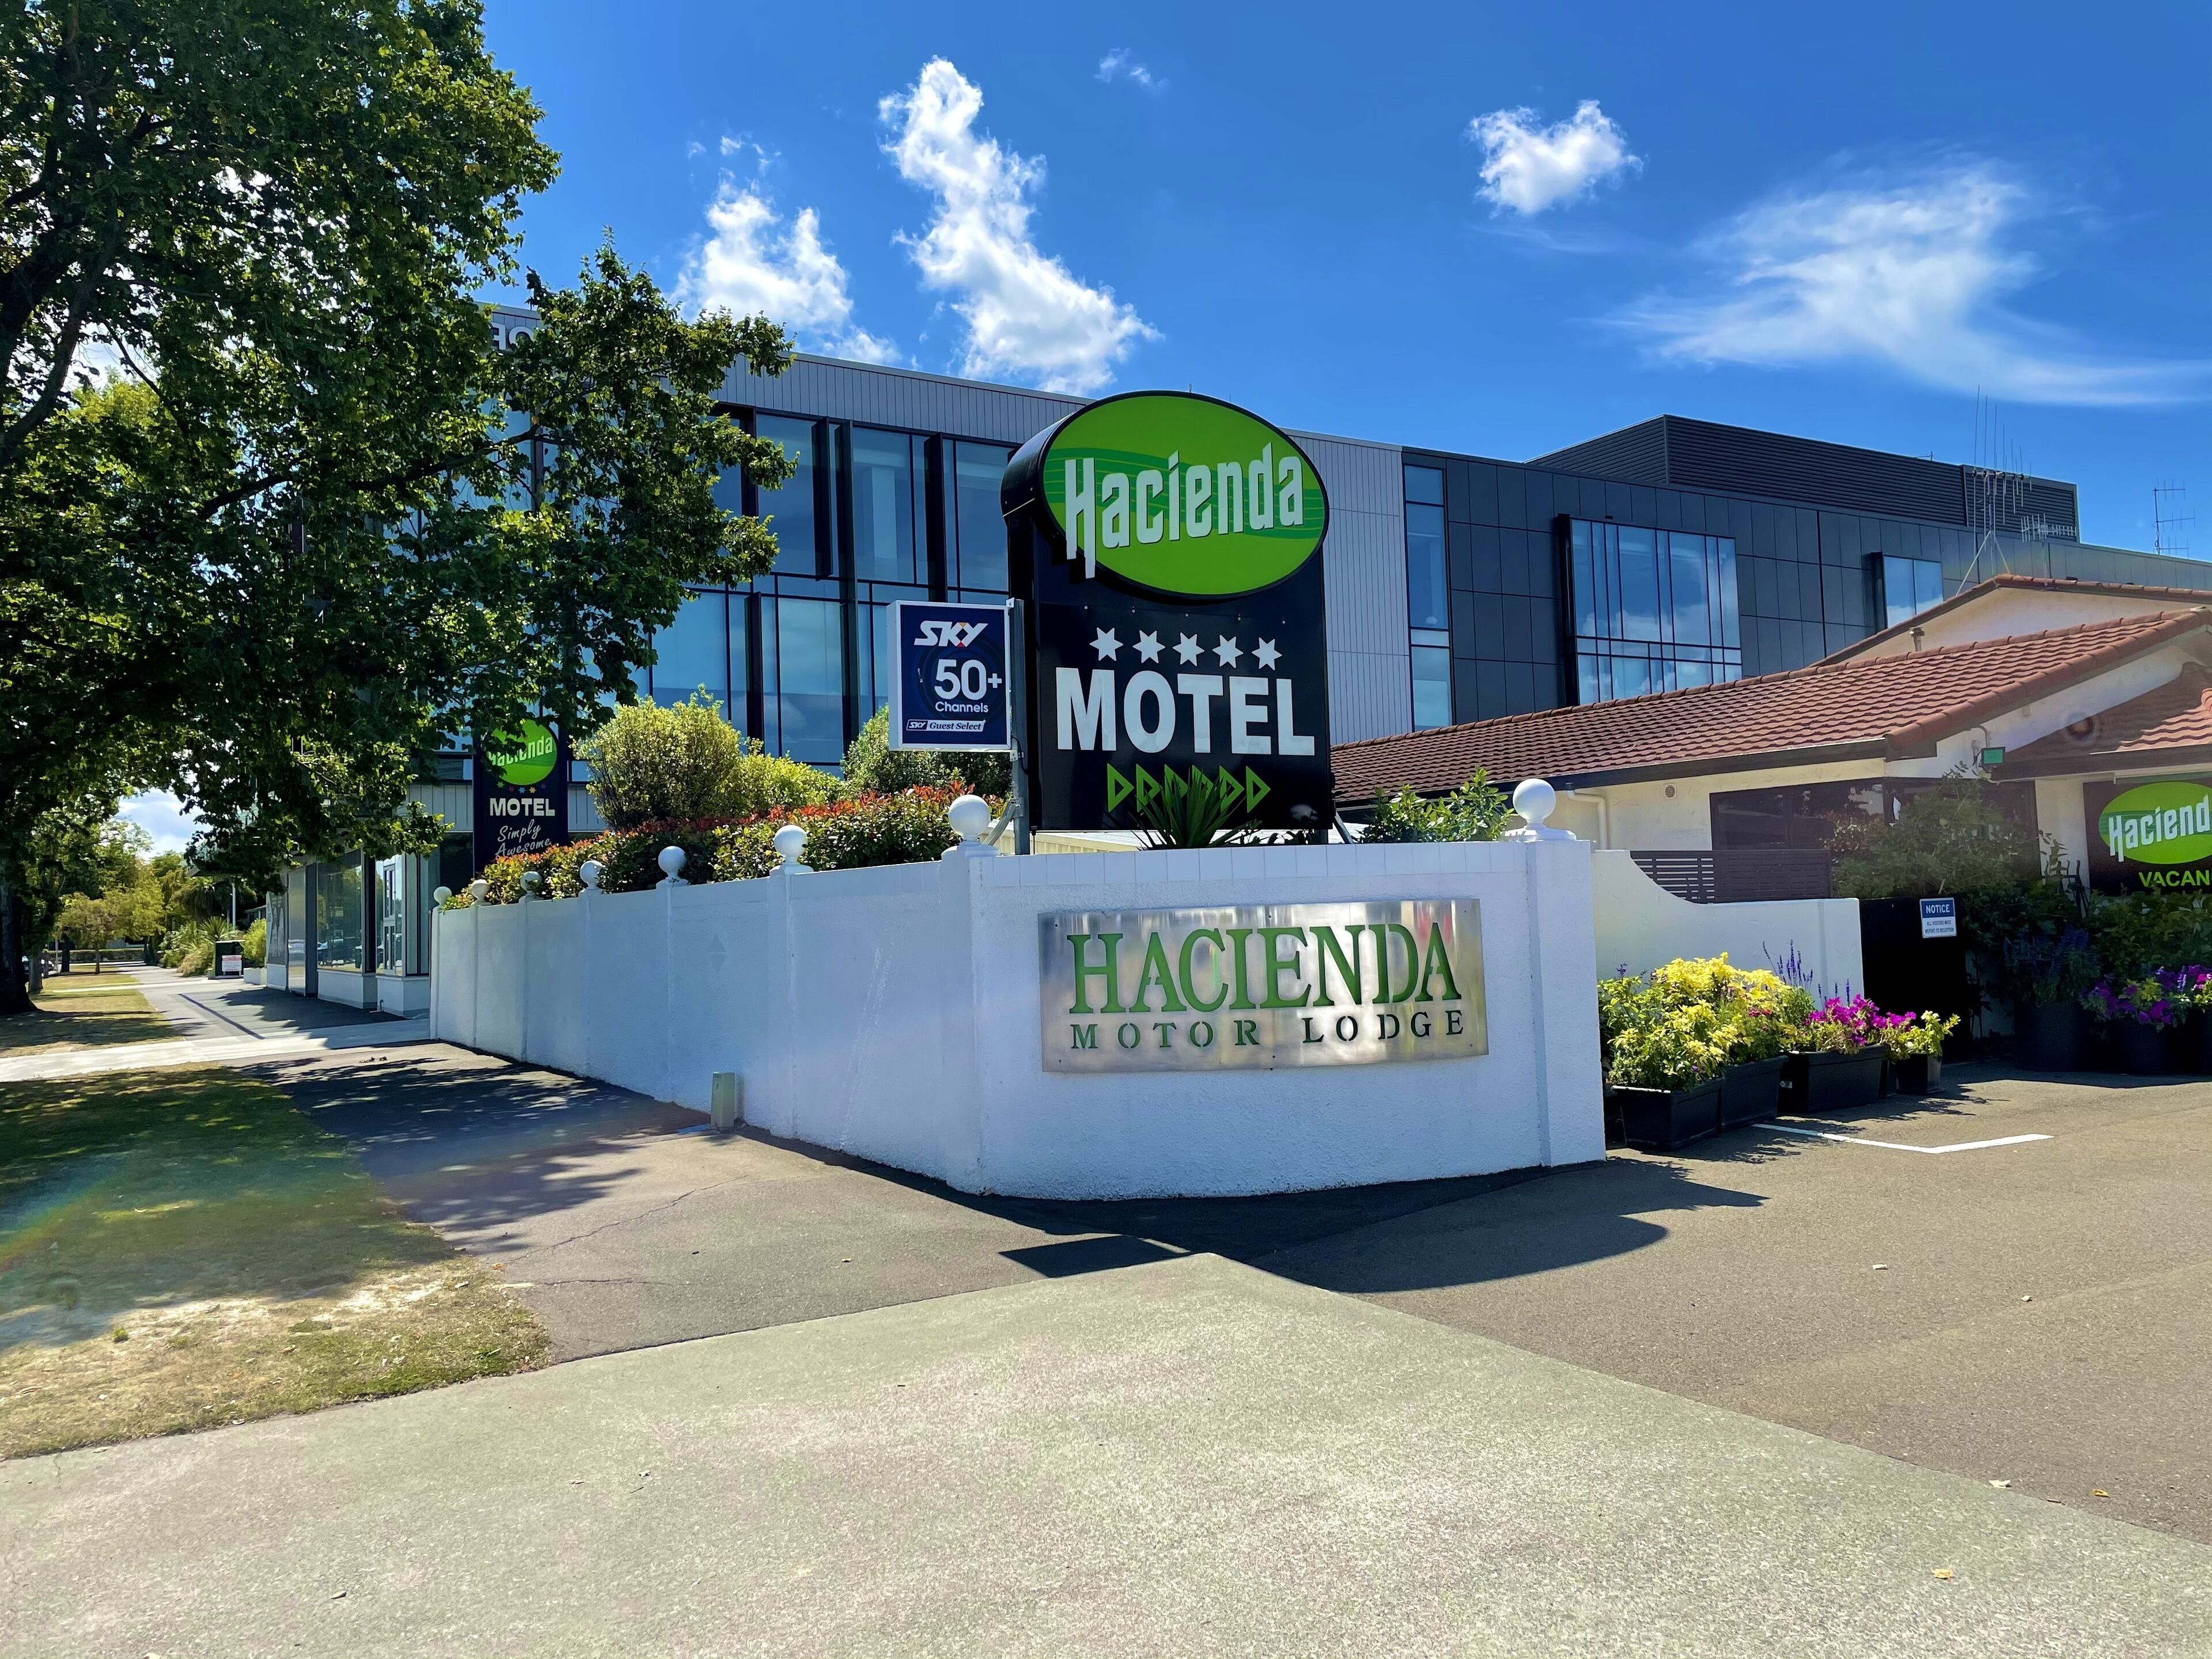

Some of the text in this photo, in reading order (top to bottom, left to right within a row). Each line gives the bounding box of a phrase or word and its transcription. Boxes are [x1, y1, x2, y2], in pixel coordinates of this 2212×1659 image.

[1064, 442, 1305, 579] Hacienda
[914, 620, 988, 647] SKY
[934, 659, 1002, 700] 50+
[935, 701, 988, 713] Channels
[1055, 667, 1315, 756] MOTEL
[490, 798, 555, 816] MOTEL
[497, 819, 541, 843] Simply
[2108, 794, 2211, 862] Haciend
[494, 838, 552, 858] Awesome
[2138, 870, 2212, 887] VACAN
[1926, 904, 1950, 914] NOTICE
[1066, 922, 1462, 1014] HACIENDA
[1070, 1009, 1464, 1050] MOTOR LODGE
